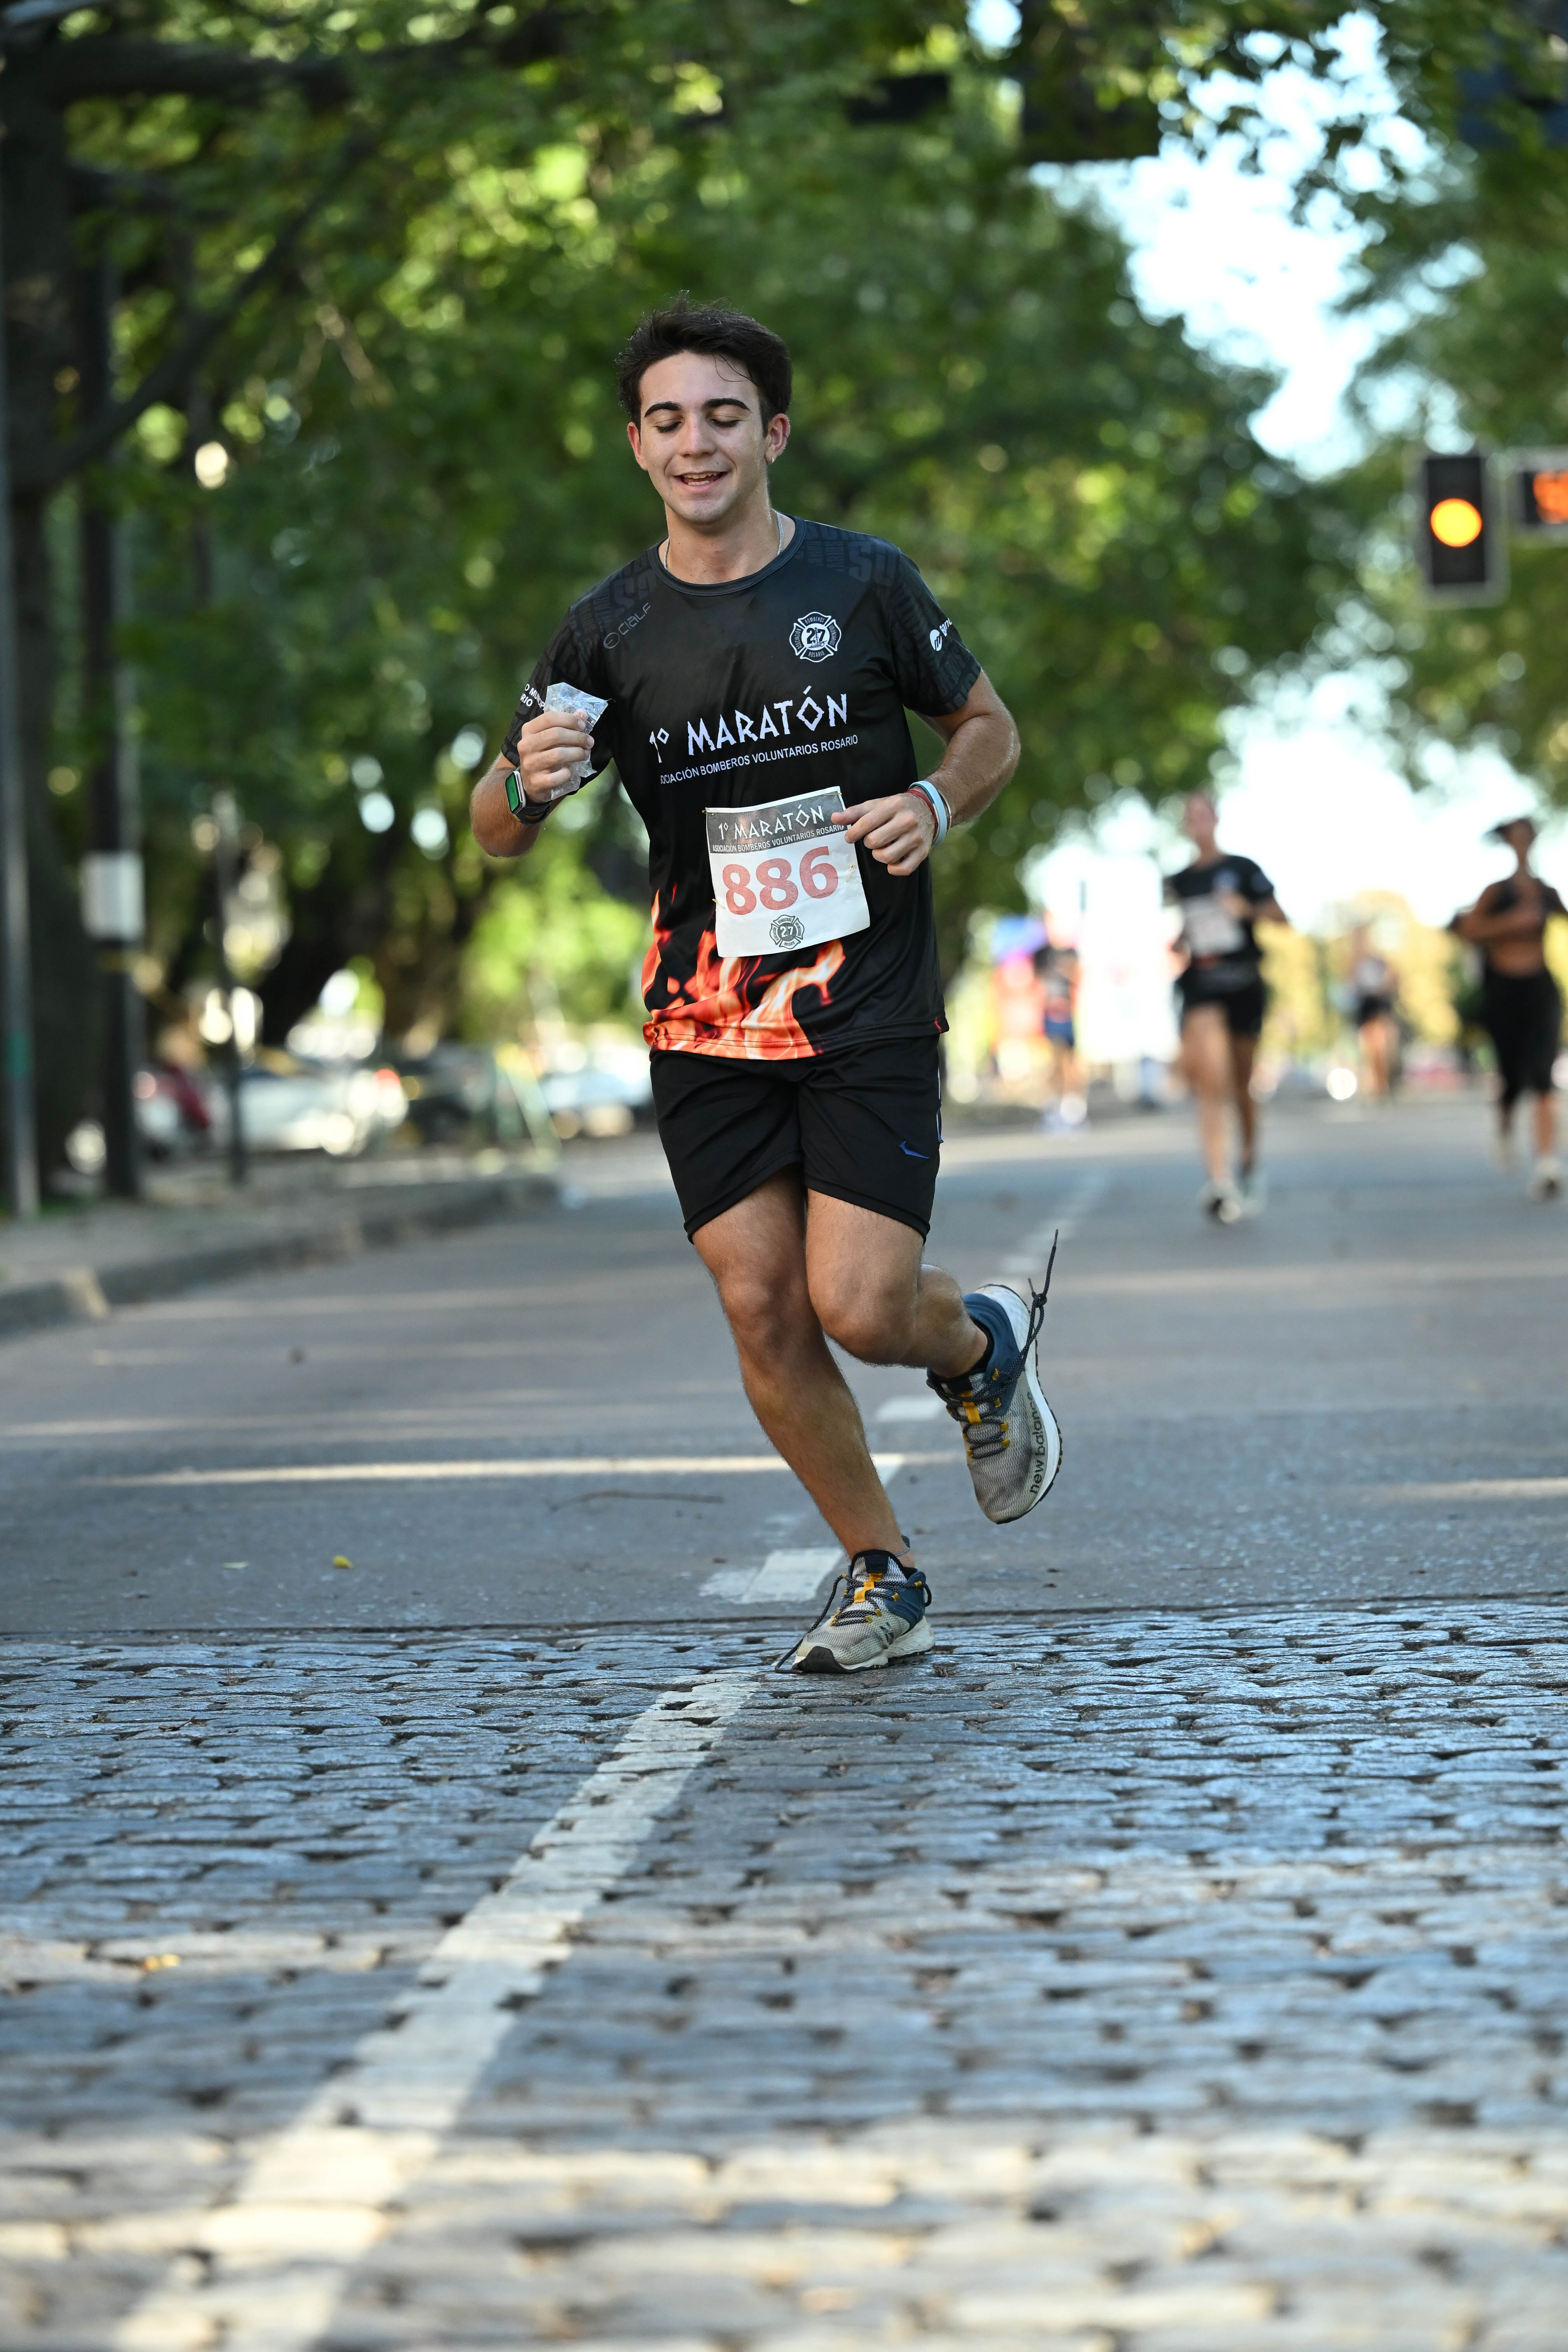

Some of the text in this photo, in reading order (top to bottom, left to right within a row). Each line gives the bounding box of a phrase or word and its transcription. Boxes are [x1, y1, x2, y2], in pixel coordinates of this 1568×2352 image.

[806, 627, 826, 644] 27
[828, 625, 837, 646] VOLUNTARIOS
[520, 693, 533, 707] RIO
[529, 688, 545, 710] MUNICIP
[687, 685, 847, 756] MARATÓN
[660, 734, 858, 784] OCIACIÓN BOMBEROS VOLUNTARIOS ROSARIO
[734, 804, 824, 840] MARATÓN
[712, 824, 844, 852] ASOCIACIÓN BOMBEROS VOLUNTARIOS ROSARIO
[722, 846, 838, 915] 886
[780, 926, 794, 938] 27
[1030, 1459, 1044, 1494] new
